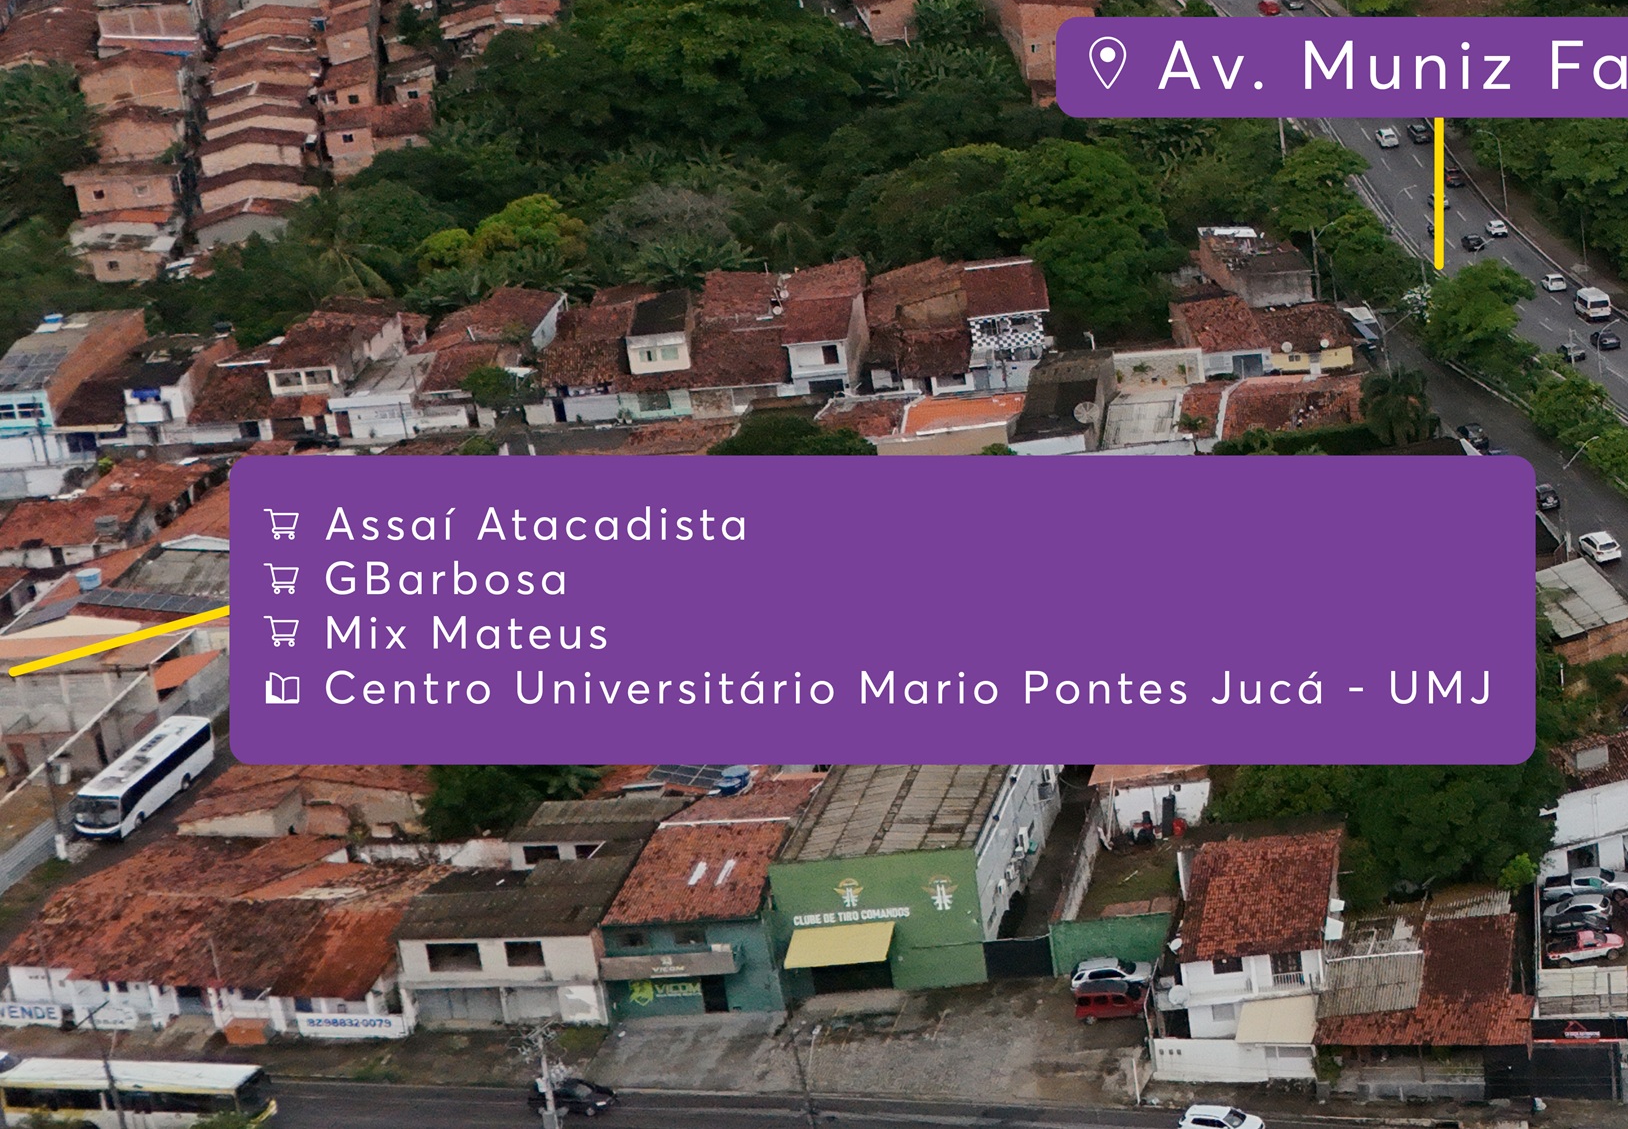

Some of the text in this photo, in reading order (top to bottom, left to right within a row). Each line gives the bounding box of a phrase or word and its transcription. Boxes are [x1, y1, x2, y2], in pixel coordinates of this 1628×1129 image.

[793, 907, 911, 926] CLUBE DE TIRO COMANDOS
